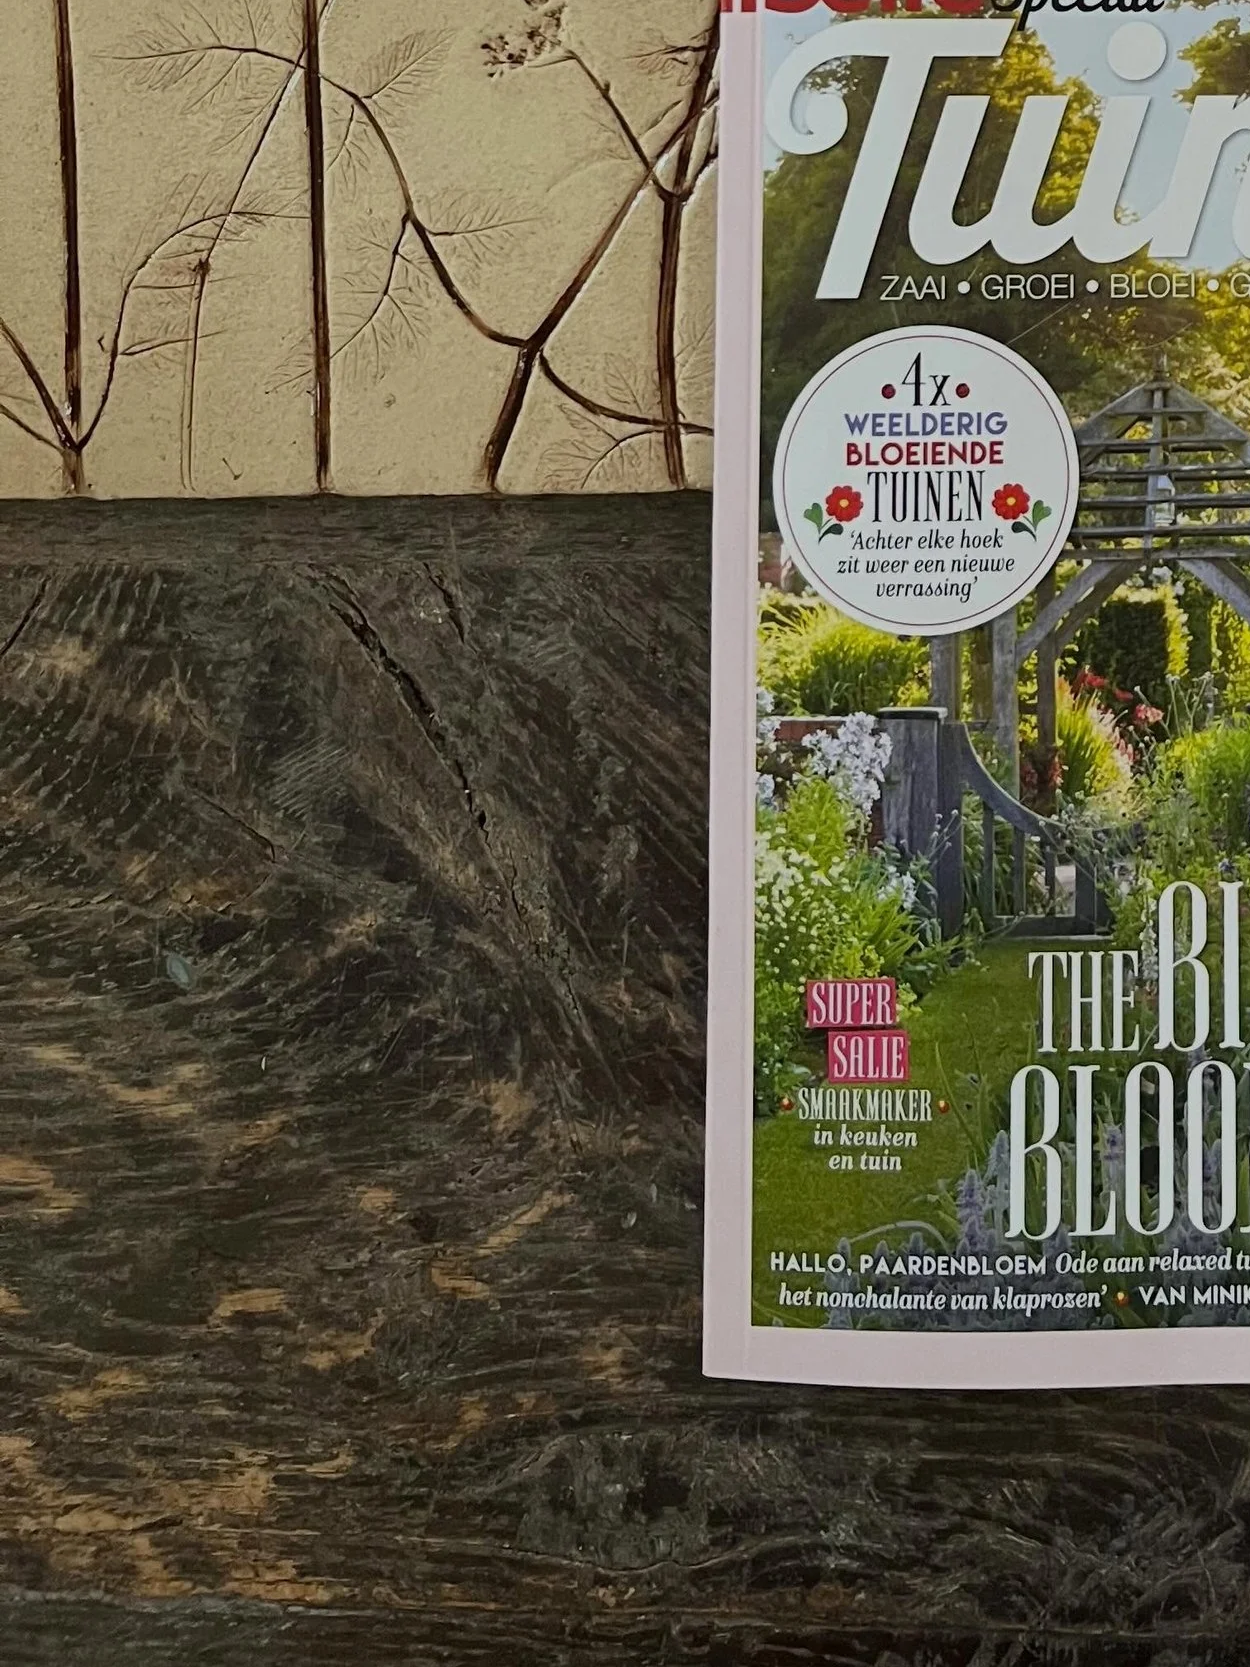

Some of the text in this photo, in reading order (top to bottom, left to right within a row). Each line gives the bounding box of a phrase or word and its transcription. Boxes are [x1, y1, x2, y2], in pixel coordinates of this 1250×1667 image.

[879, 274, 946, 300] ZAAI
[981, 273, 1074, 299] GROEI
[1110, 271, 1196, 298] BLOEI
[901, 351, 951, 406] 4x
[844, 411, 1008, 436] WEELDERIG
[846, 440, 1004, 465] BLOEIENDE
[867, 469, 986, 522] TUINEN
[918, 529, 953, 548] elke
[960, 527, 1004, 547] hoek
[837, 555, 1015, 573] zit weer een nieuwe
[812, 981, 893, 1024] SUPER
[1028, 949, 1139, 1052] THE
[833, 1034, 904, 1077] SALIE
[798, 1086, 932, 1120] SMAAKMAKER
[814, 1123, 918, 1146] in keuken
[829, 1148, 902, 1170] en tuin
[770, 1251, 853, 1275] HALLO,
[860, 1254, 1047, 1275] PAARDENBLOEM
[1055, 1251, 1099, 1273] Ode
[1102, 1255, 1145, 1272] aan
[1149, 1249, 1232, 1271] relaxed
[778, 1281, 813, 1305] het
[815, 1284, 946, 1309] nonchalante
[951, 1290, 989, 1309] van
[1138, 1283, 1187, 1305] VAN
